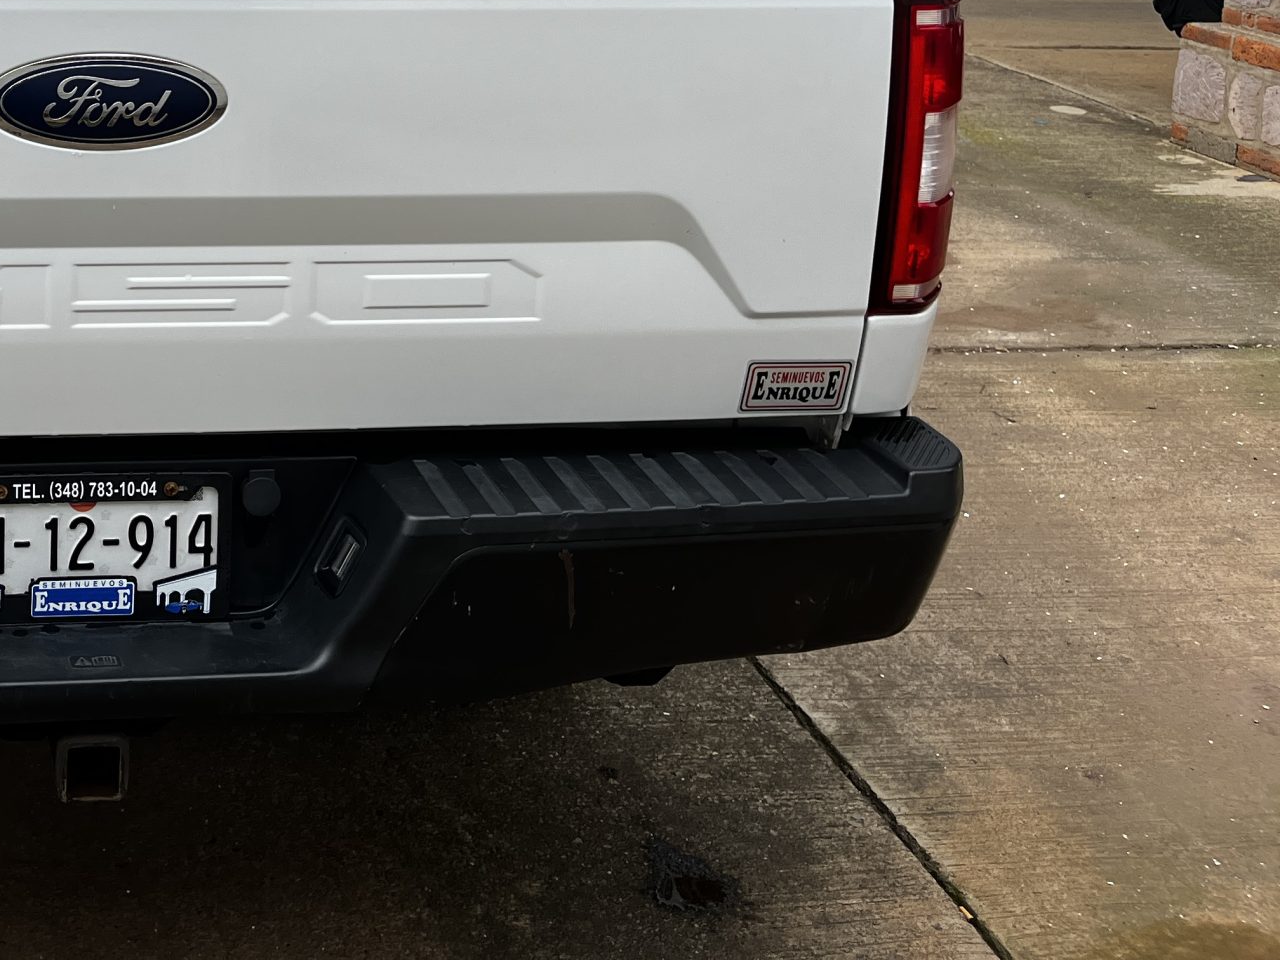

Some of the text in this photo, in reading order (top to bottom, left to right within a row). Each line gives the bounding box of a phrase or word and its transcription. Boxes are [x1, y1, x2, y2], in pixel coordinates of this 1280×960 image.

[42, 74, 172, 128] Ford
[751, 371, 841, 403] ENRIQUE
[770, 371, 825, 384] SEMINUEVOS
[13, 481, 157, 500] TEL. (348) 783-10-04
[42, 579, 125, 589] SEMINUEVOS
[33, 589, 132, 614] ENRIQUE
